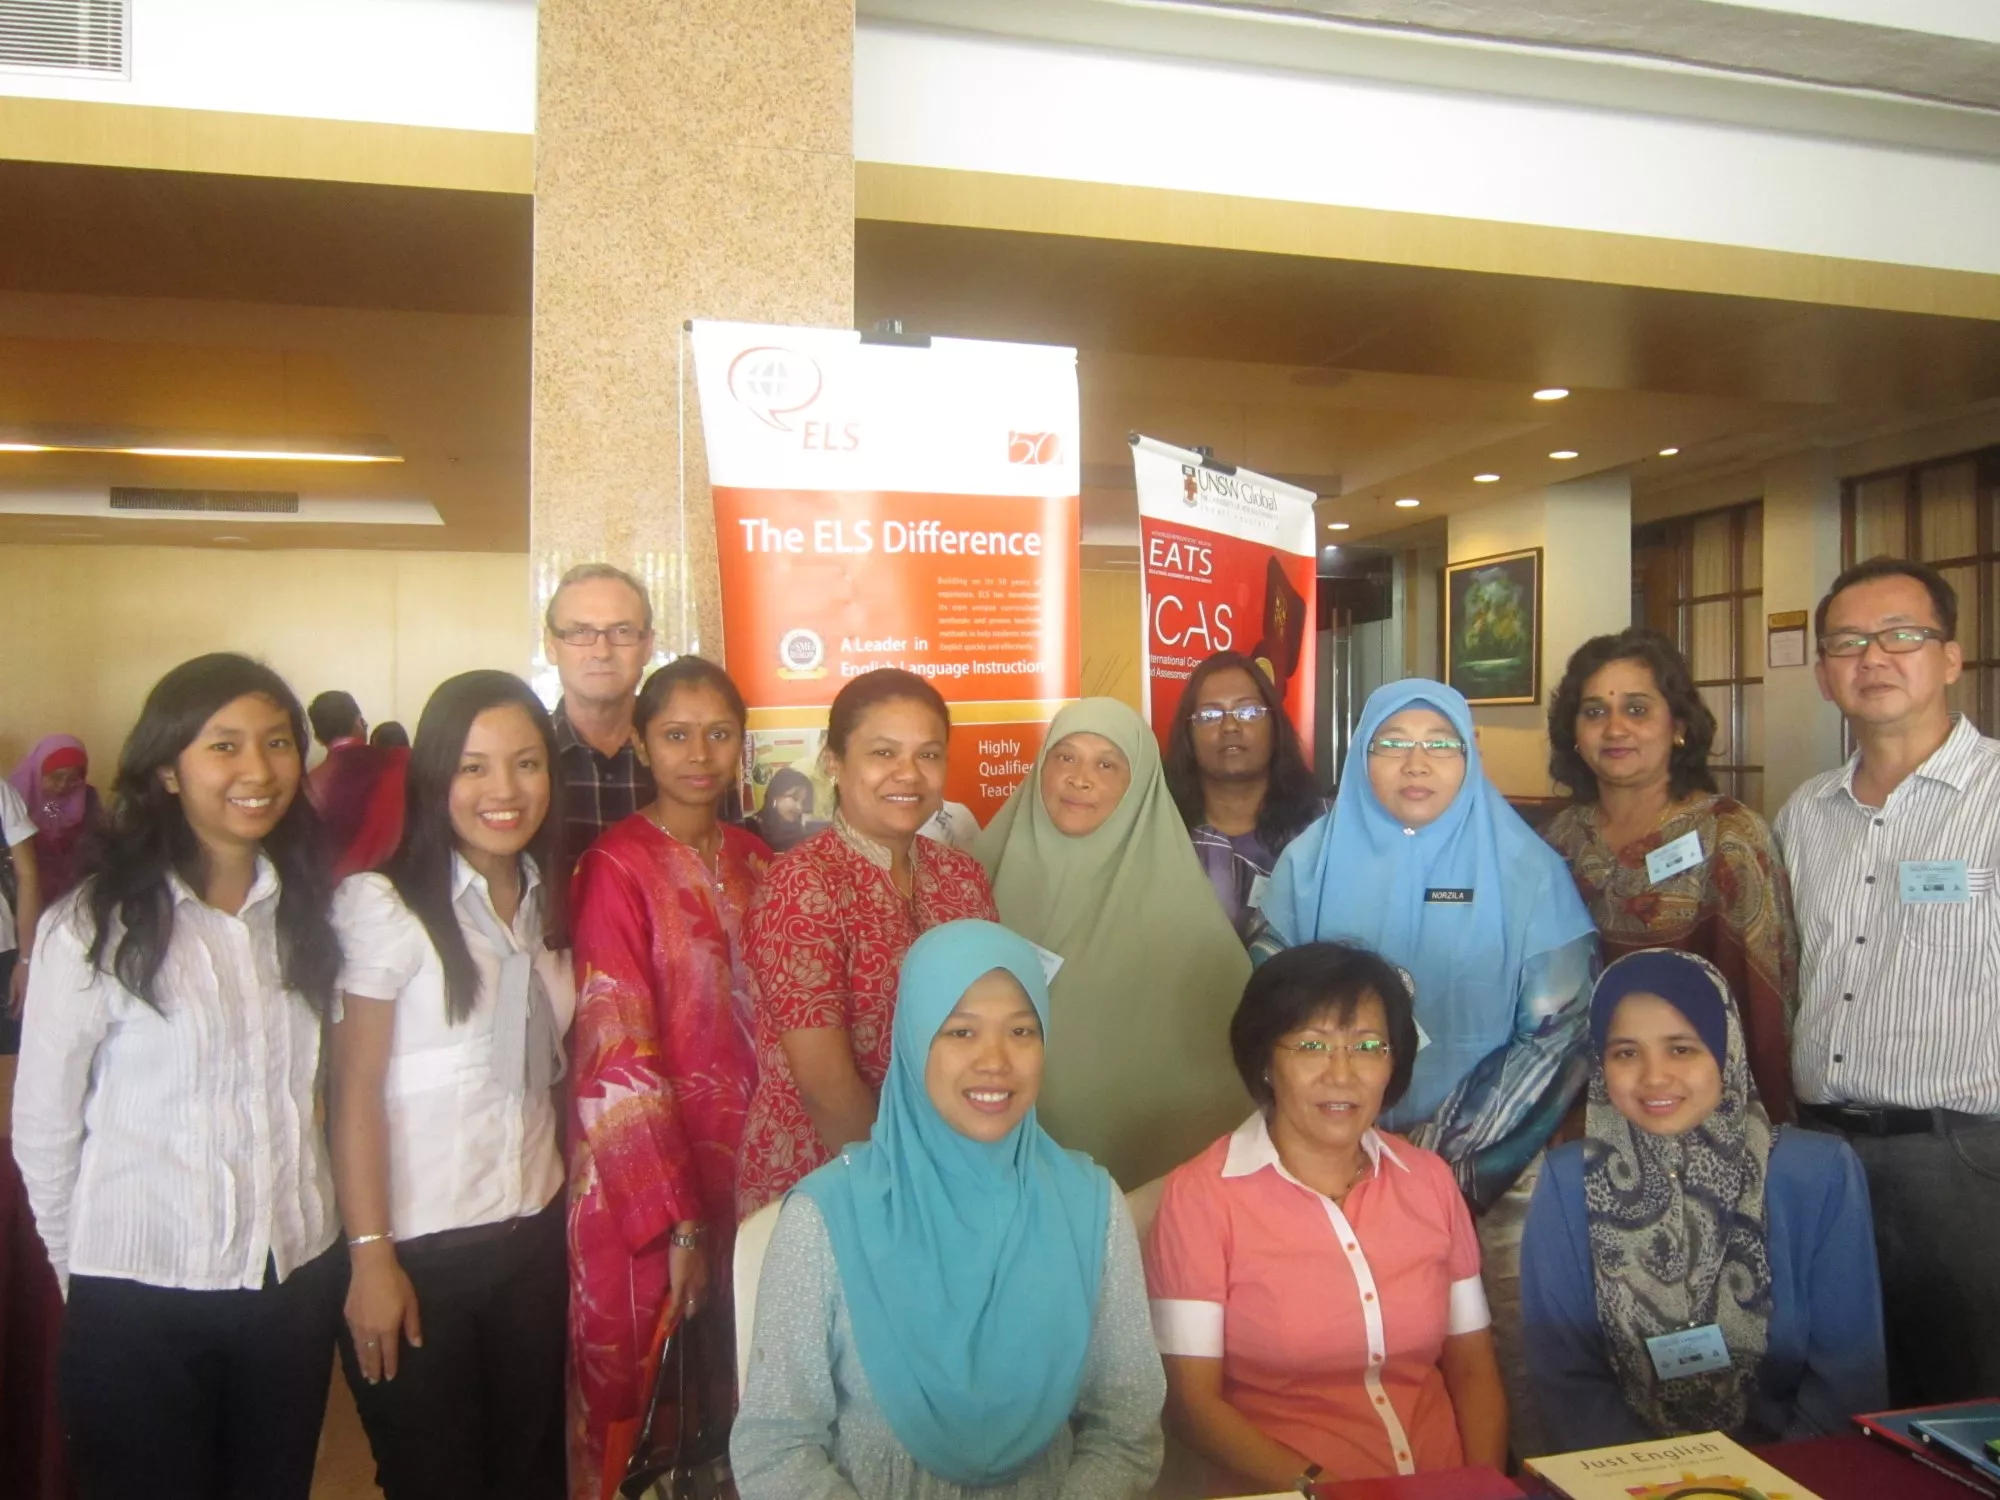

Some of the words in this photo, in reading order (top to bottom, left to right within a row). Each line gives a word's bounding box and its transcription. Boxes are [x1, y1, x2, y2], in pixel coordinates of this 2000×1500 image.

[803, 421, 860, 451] ELS
[1197, 469, 1239, 499] UNSW
[1241, 483, 1278, 511] Global
[738, 518, 805, 553] The
[814, 520, 874, 554] ELS
[883, 520, 1042, 556] Difference
[1149, 538, 1212, 575] EATS
[1147, 592, 1232, 651] ICAS
[841, 637, 852, 652] A
[856, 637, 907, 651] Leader
[914, 636, 928, 650] in
[973, 659, 1045, 675] Instruction
[1149, 653, 1186, 667] ternational
[978, 738, 1021, 758] Highly
[1431, 891, 1465, 899] NORZILA
[1580, 1456, 1629, 1470] Just
[1630, 1442, 1720, 1463] English
